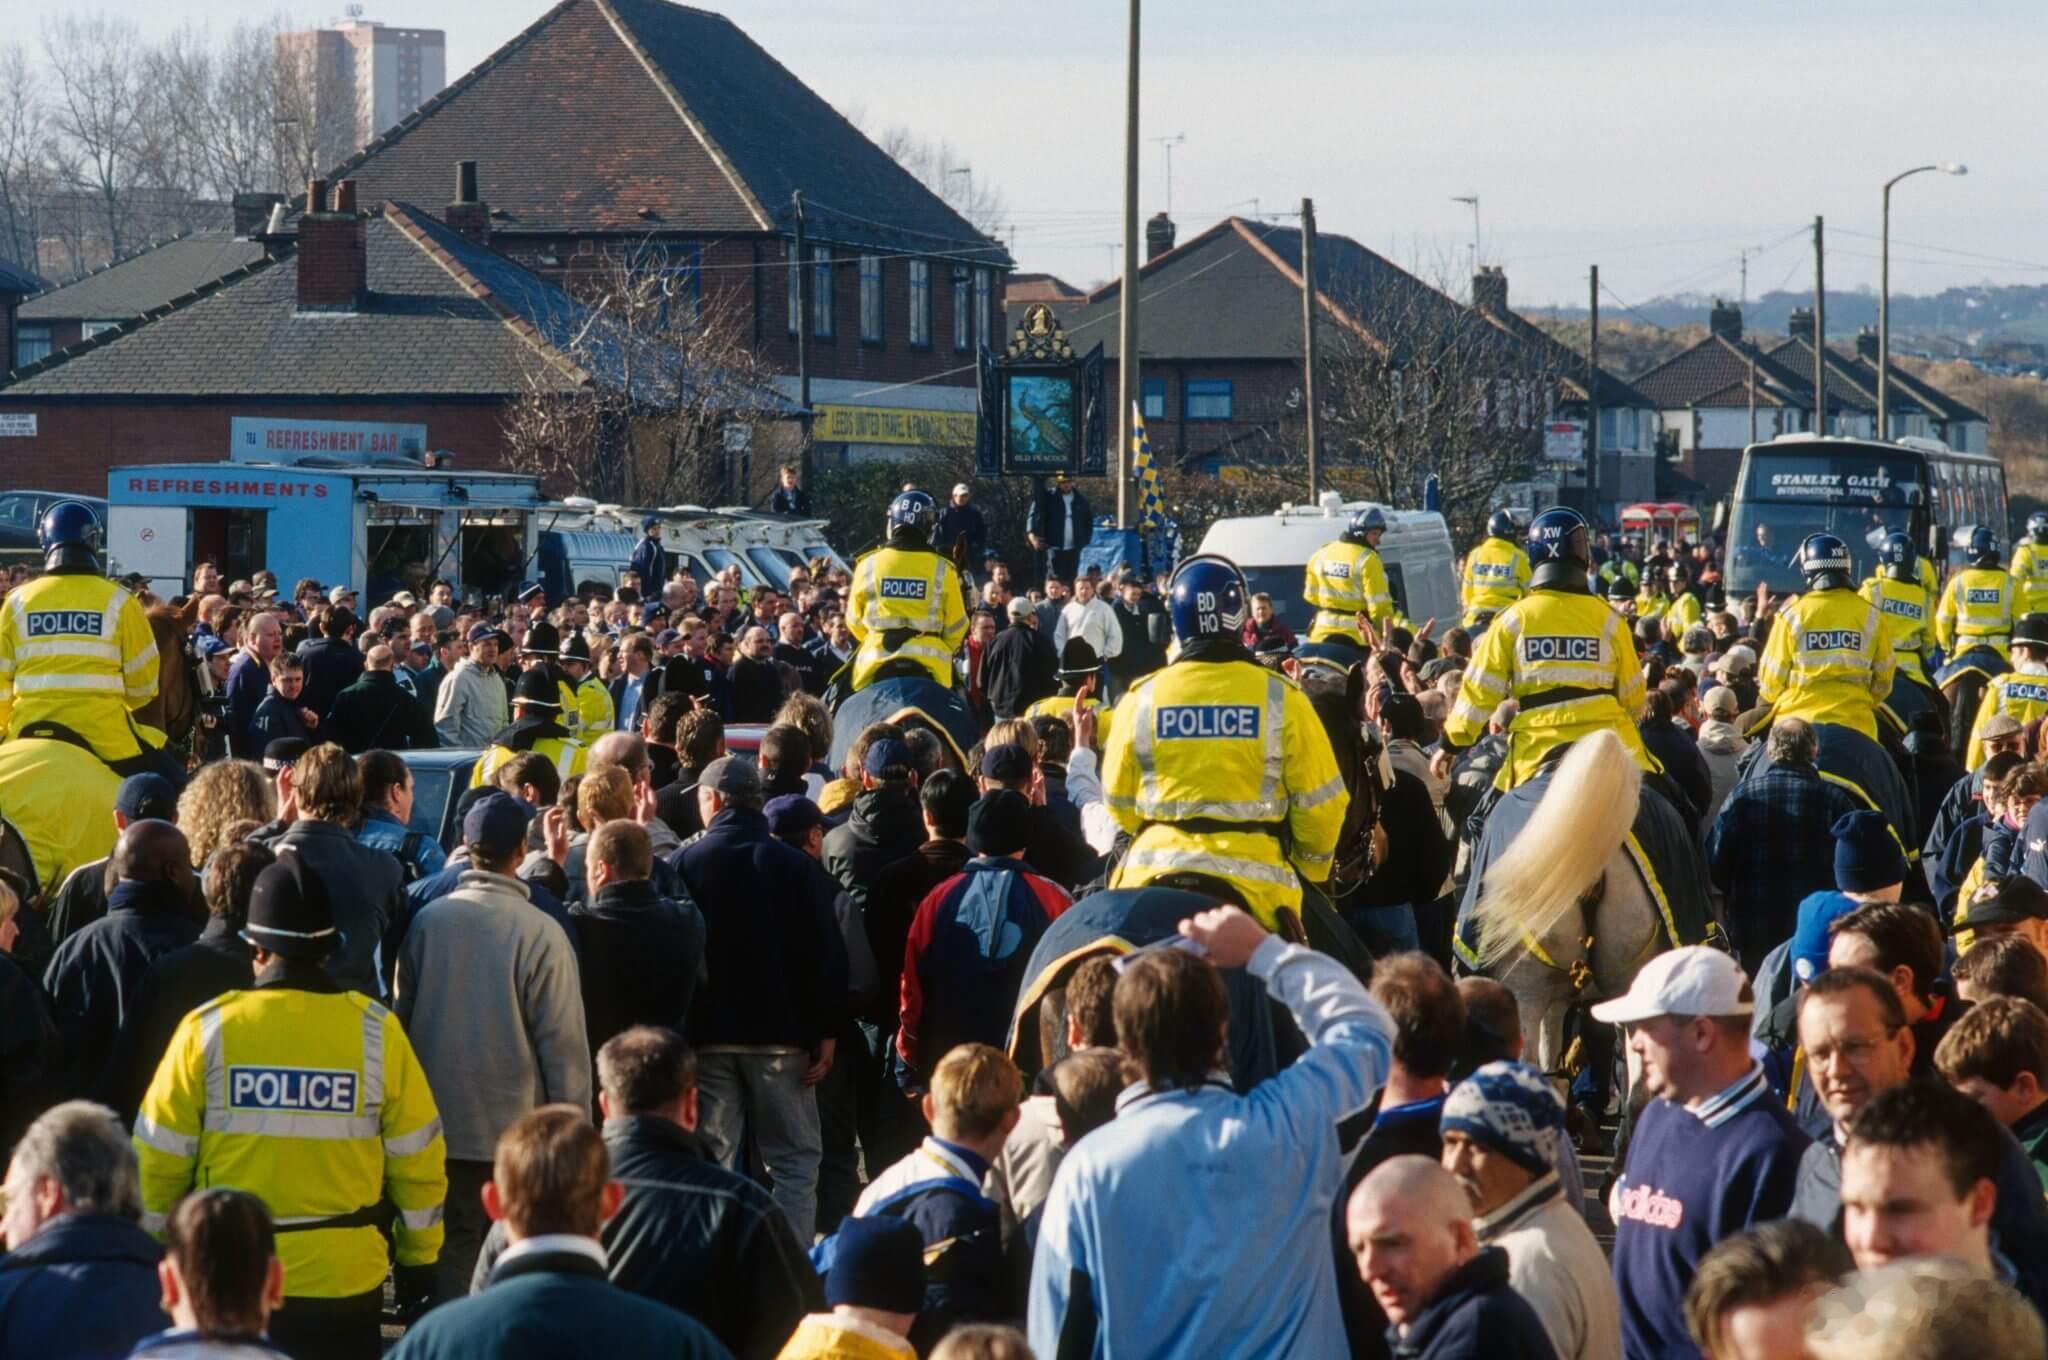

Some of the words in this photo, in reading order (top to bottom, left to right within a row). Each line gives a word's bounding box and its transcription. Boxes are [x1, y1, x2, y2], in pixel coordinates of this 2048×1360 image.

[266, 430, 365, 450] REFRESHMENT
[370, 432, 397, 452] BAR
[128, 478, 328, 498] REFRESHMENTS
[1771, 474, 1841, 486] STANLEY
[1776, 486, 1844, 496] INTERNATIONAL
[1543, 527, 1561, 539] XW
[1547, 542, 1560, 558] X
[883, 580, 924, 597] POLICE
[1968, 591, 1998, 601] POLICE
[1197, 591, 1216, 612] BD
[1884, 599, 1921, 618] POLICE
[30, 613, 99, 633] POLICE
[1199, 614, 1219, 633] HQ
[1527, 638, 1598, 660] POLICE
[1808, 632, 1860, 650] POLICE
[1161, 708, 1254, 736] POLICE
[234, 1071, 352, 1110] POLICE
